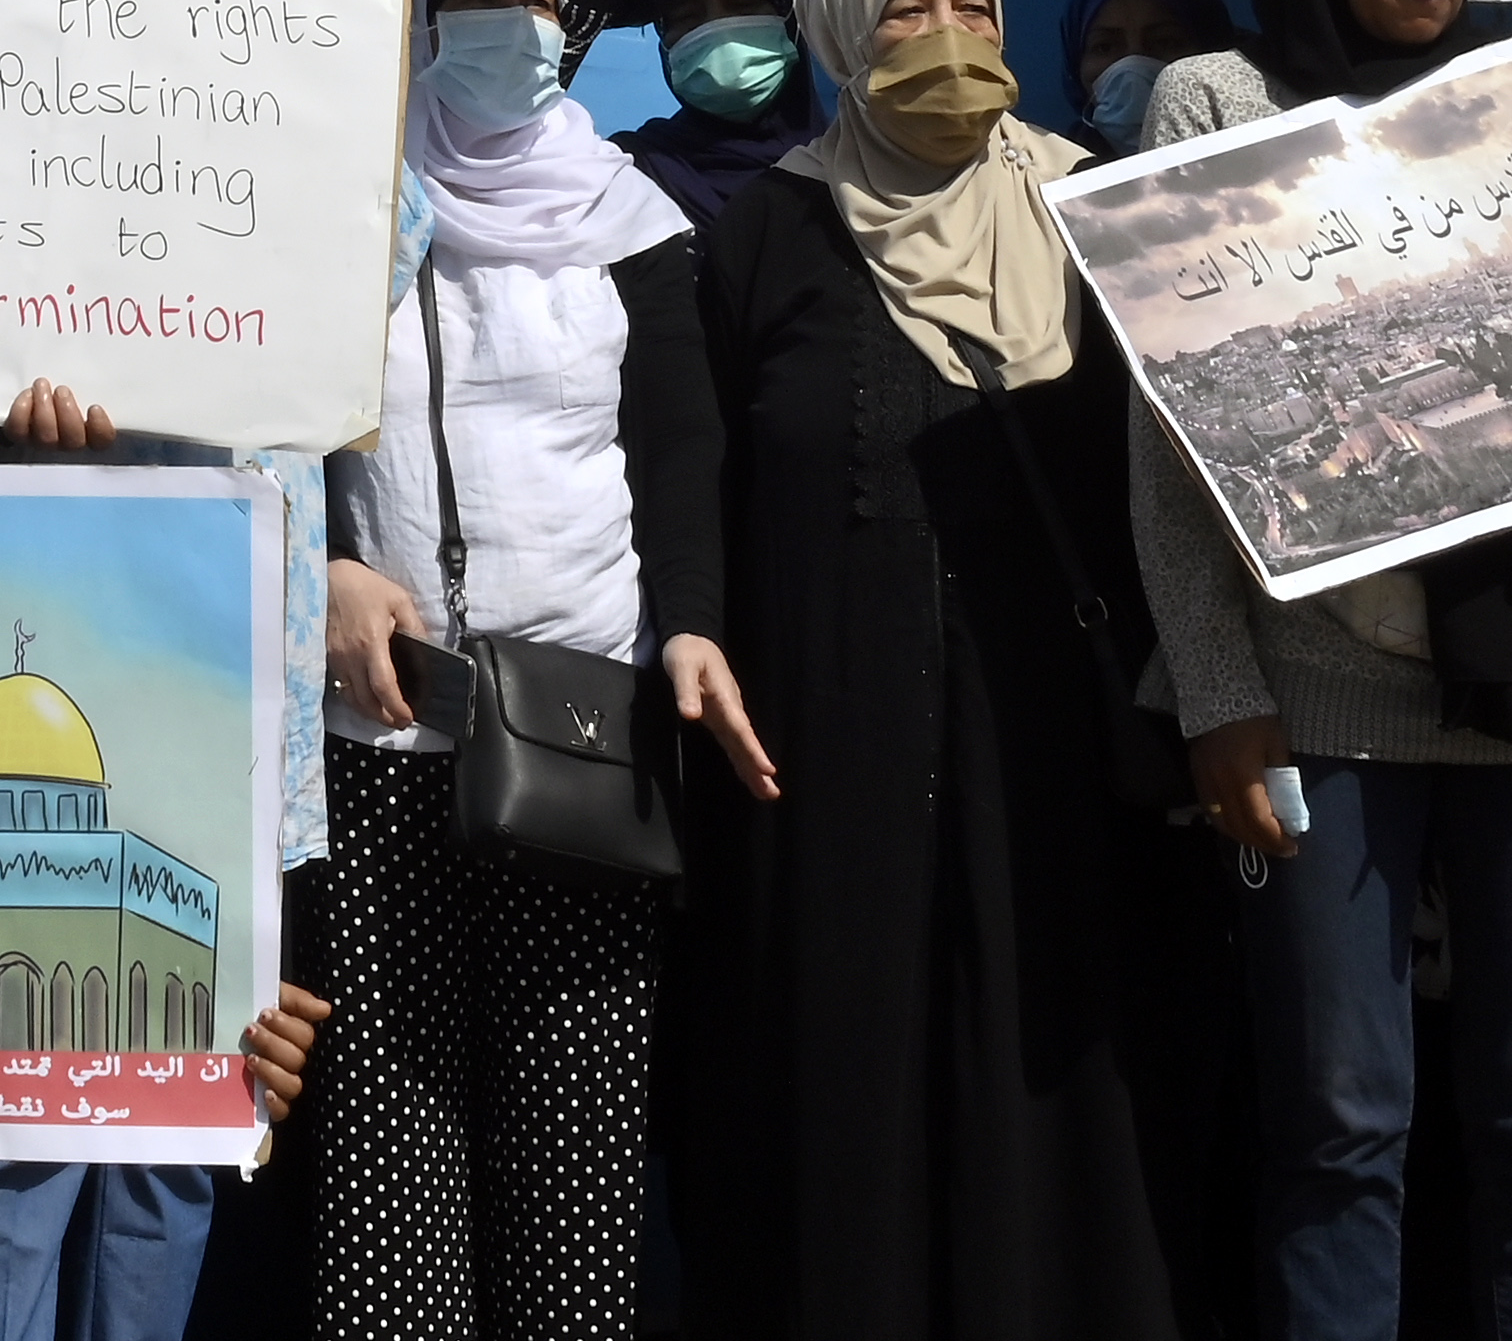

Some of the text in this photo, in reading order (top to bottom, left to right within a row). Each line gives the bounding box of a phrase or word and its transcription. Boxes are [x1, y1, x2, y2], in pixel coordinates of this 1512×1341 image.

[30, 134, 256, 236] including
[1379, 196, 1414, 261] في
[1421, 195, 1464, 238] من
[119, 217, 169, 262] to
[1285, 208, 1364, 282] القدس
[3, 1054, 51, 1077] تمتد
[68, 1055, 121, 1087] التي
[137, 1055, 184, 1084] اليد
[199, 1056, 228, 1083] ان
[61, 1096, 131, 1124] سوف
